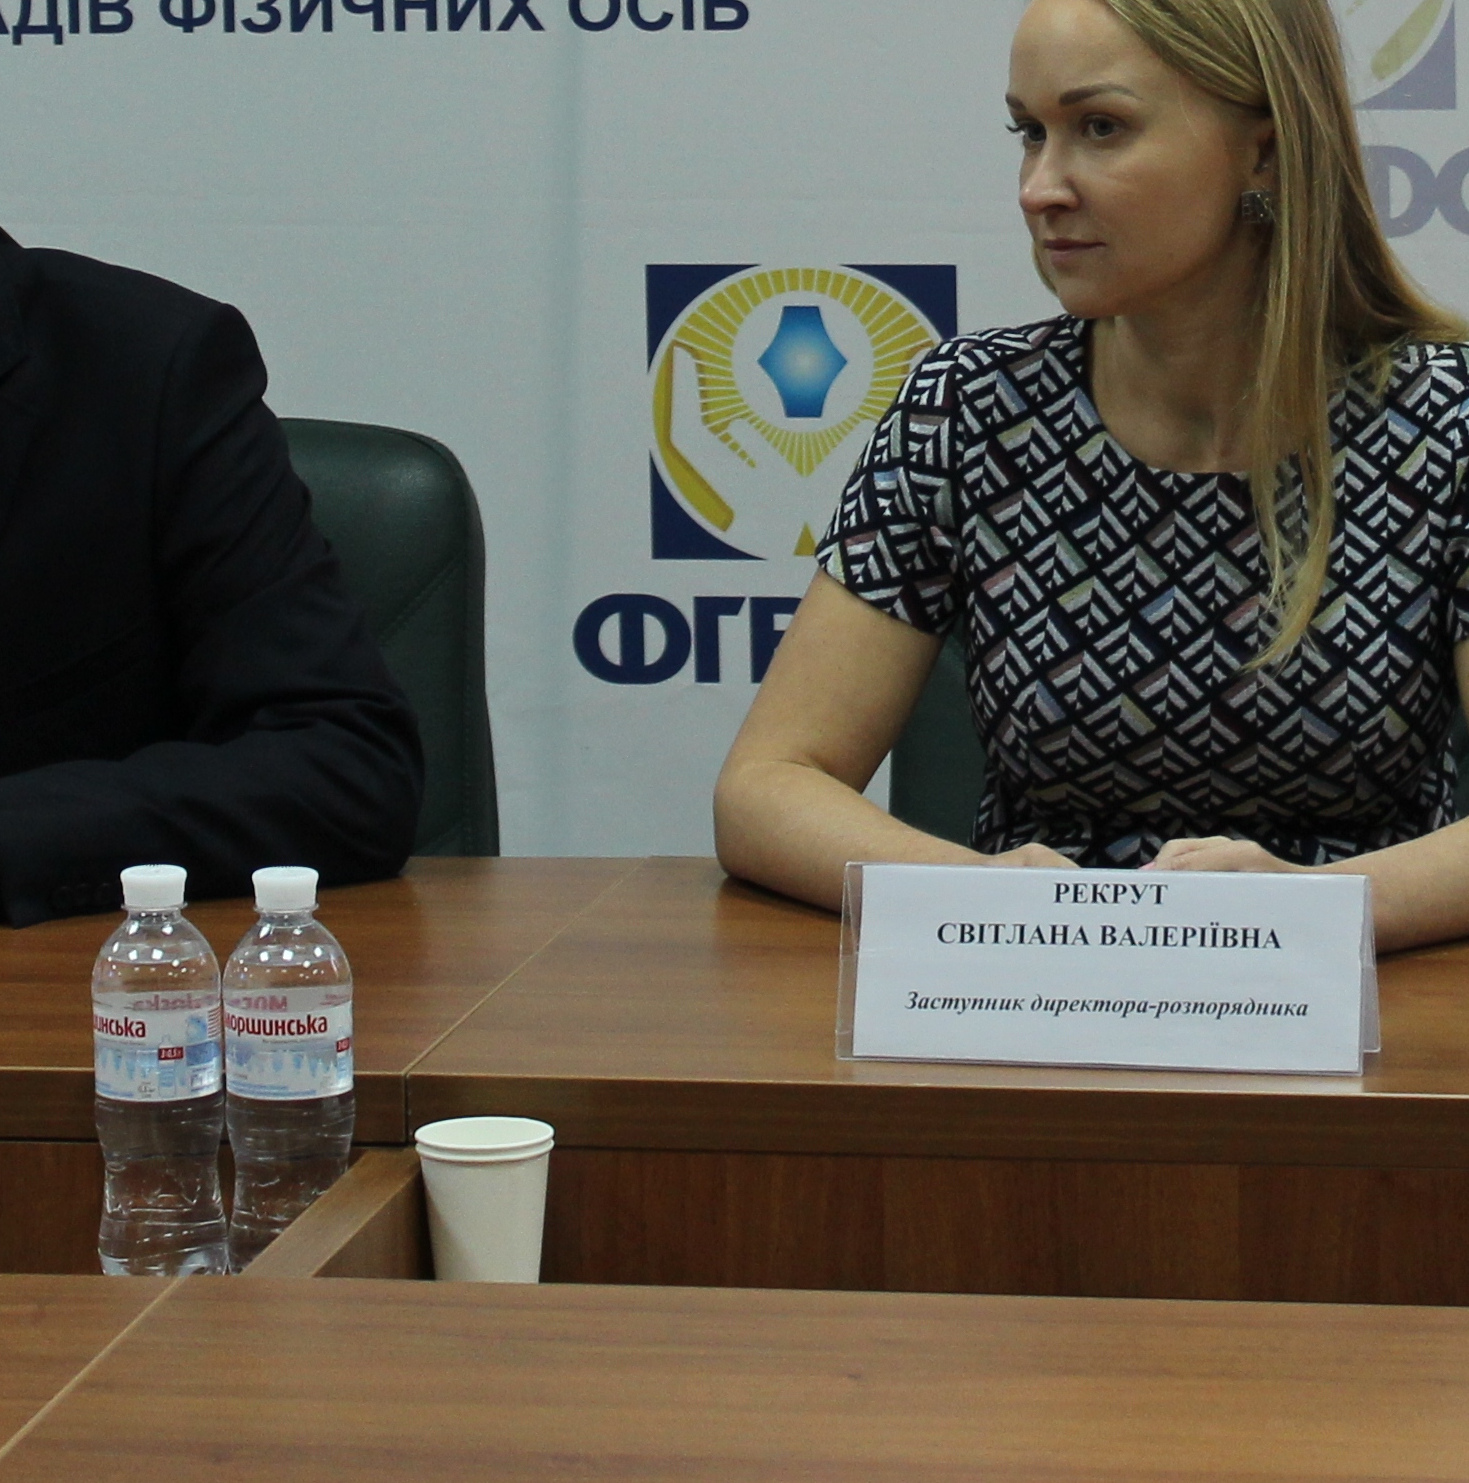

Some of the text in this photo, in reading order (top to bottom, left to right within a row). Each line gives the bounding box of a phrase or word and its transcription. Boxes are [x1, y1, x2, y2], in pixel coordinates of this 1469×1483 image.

[1052, 881, 1169, 906] РЕКРУТ
[936, 920, 1282, 949] СВІТЛАНА ВАЛЕРІЇВНА
[904, 991, 1310, 1021] Заступник директора-розпорядника
